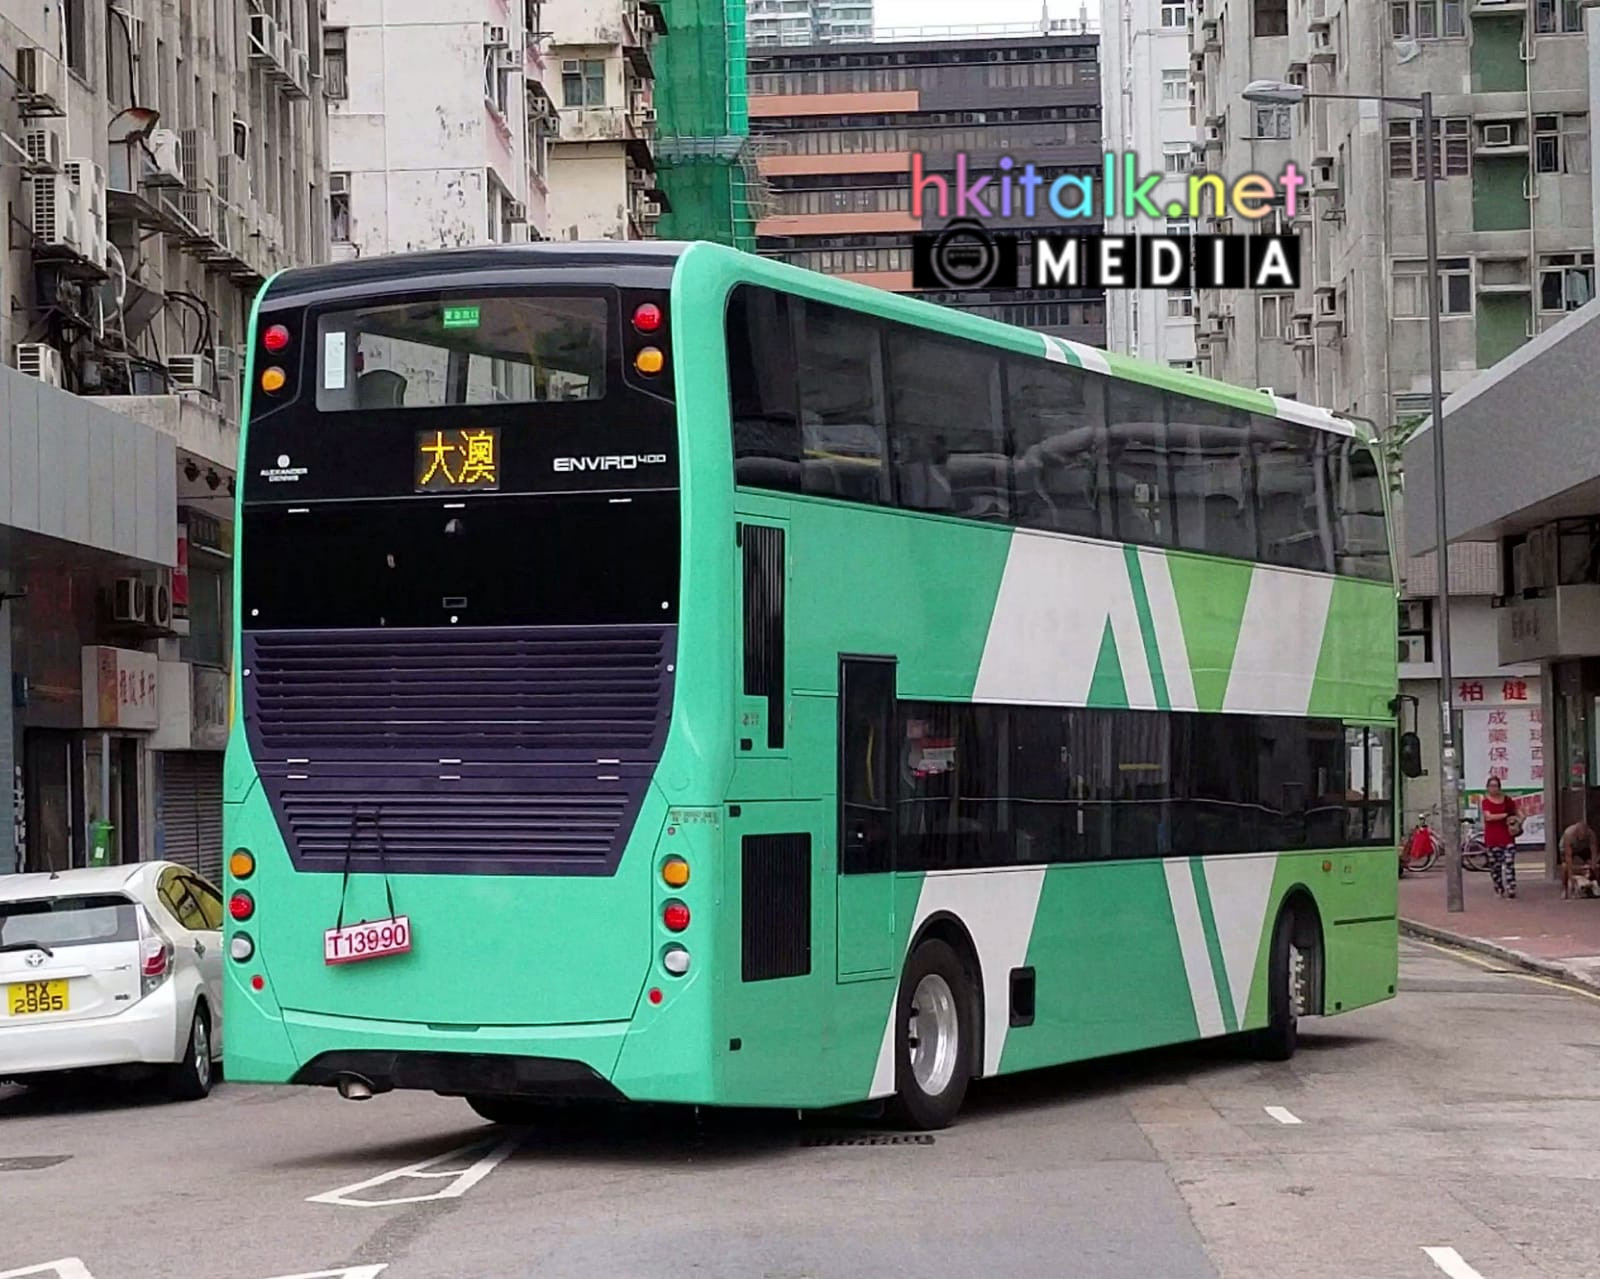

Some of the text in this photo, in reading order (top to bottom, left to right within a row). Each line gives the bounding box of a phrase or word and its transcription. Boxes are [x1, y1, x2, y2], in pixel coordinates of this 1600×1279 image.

[420, 430, 496, 485] 大澳
[328, 924, 406, 956] T13990
[26, 982, 50, 998] RX
[14, 995, 63, 1014] 2955
